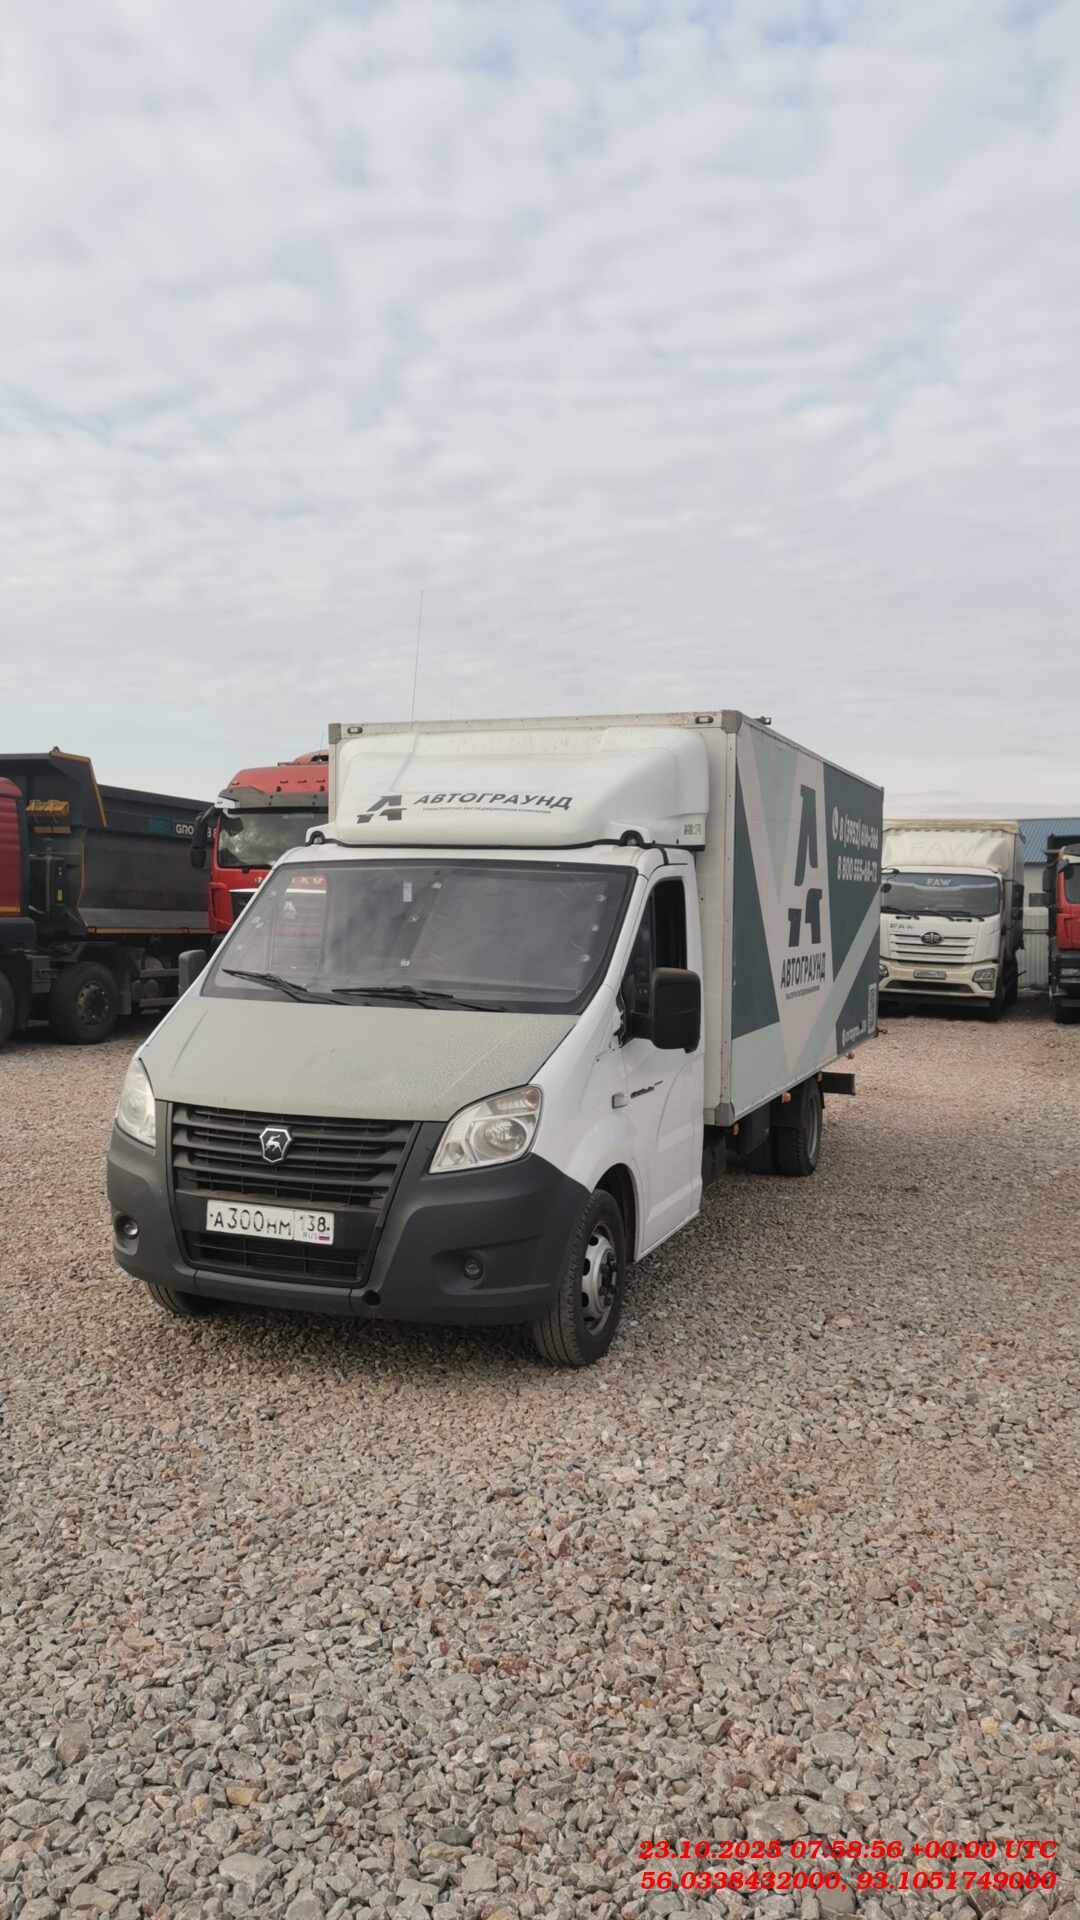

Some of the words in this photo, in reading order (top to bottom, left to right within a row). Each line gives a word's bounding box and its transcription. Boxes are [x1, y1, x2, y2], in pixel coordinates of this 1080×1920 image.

[414, 793, 573, 810] АВТОГРАУНД
[927, 876, 951, 888] FAW
[781, 952, 826, 990] АВТОГРАУНД
